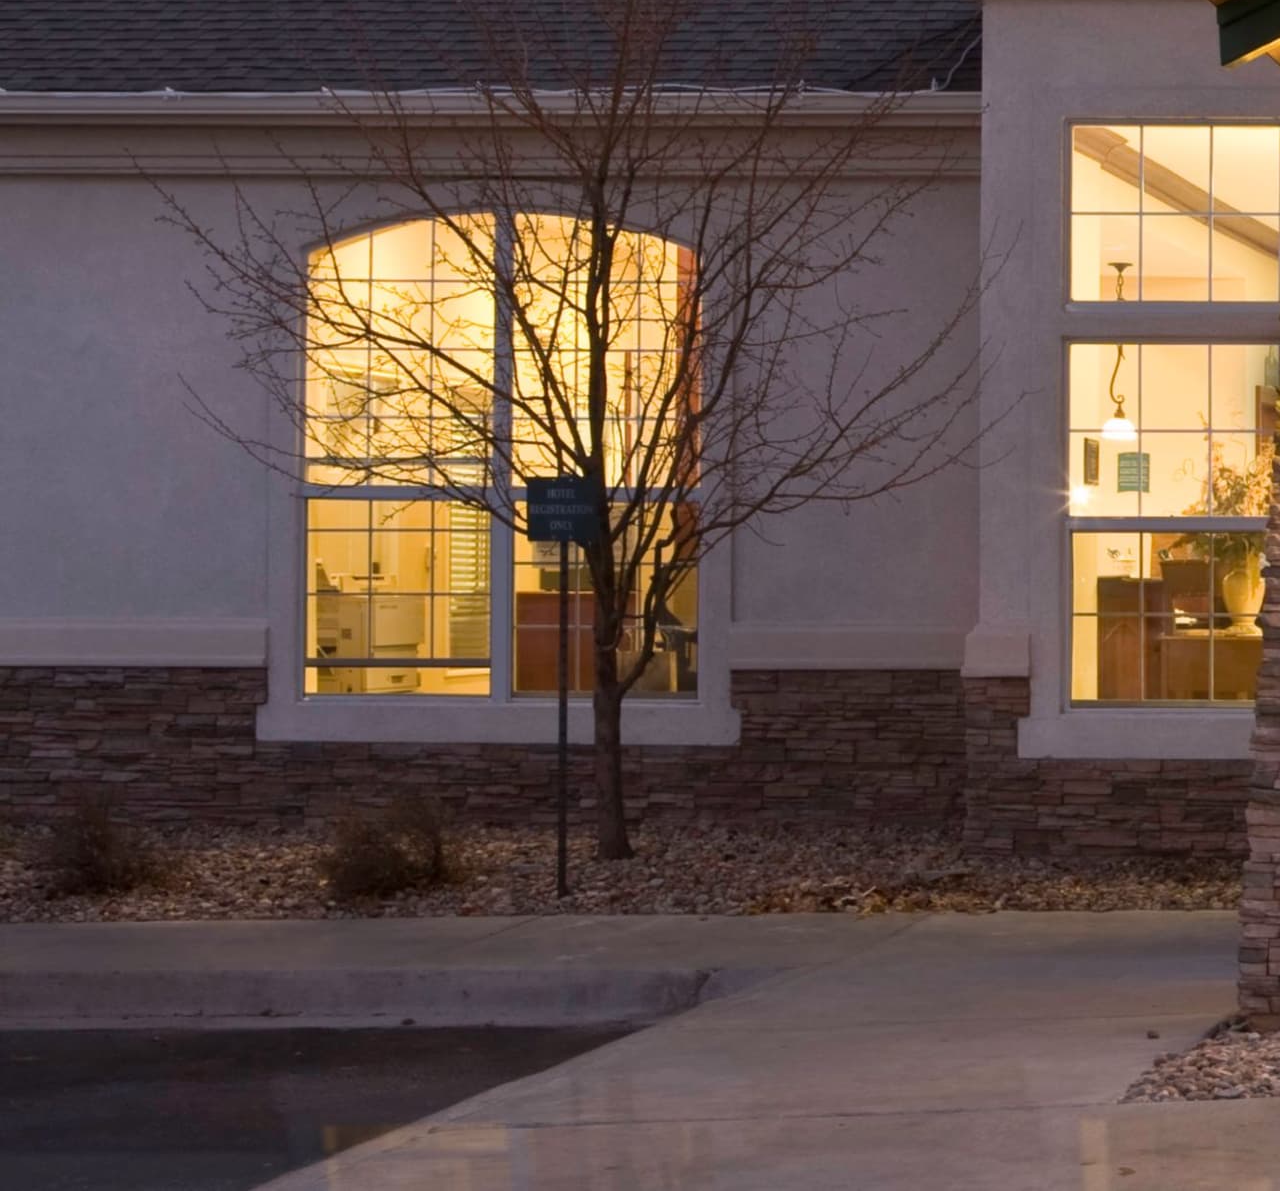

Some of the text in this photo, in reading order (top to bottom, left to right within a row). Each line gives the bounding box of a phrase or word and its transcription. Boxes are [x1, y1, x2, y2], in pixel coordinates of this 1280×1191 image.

[547, 489, 576, 498] HOTEL
[530, 504, 593, 515] REGISTRATION
[549, 520, 574, 530] ONLY
